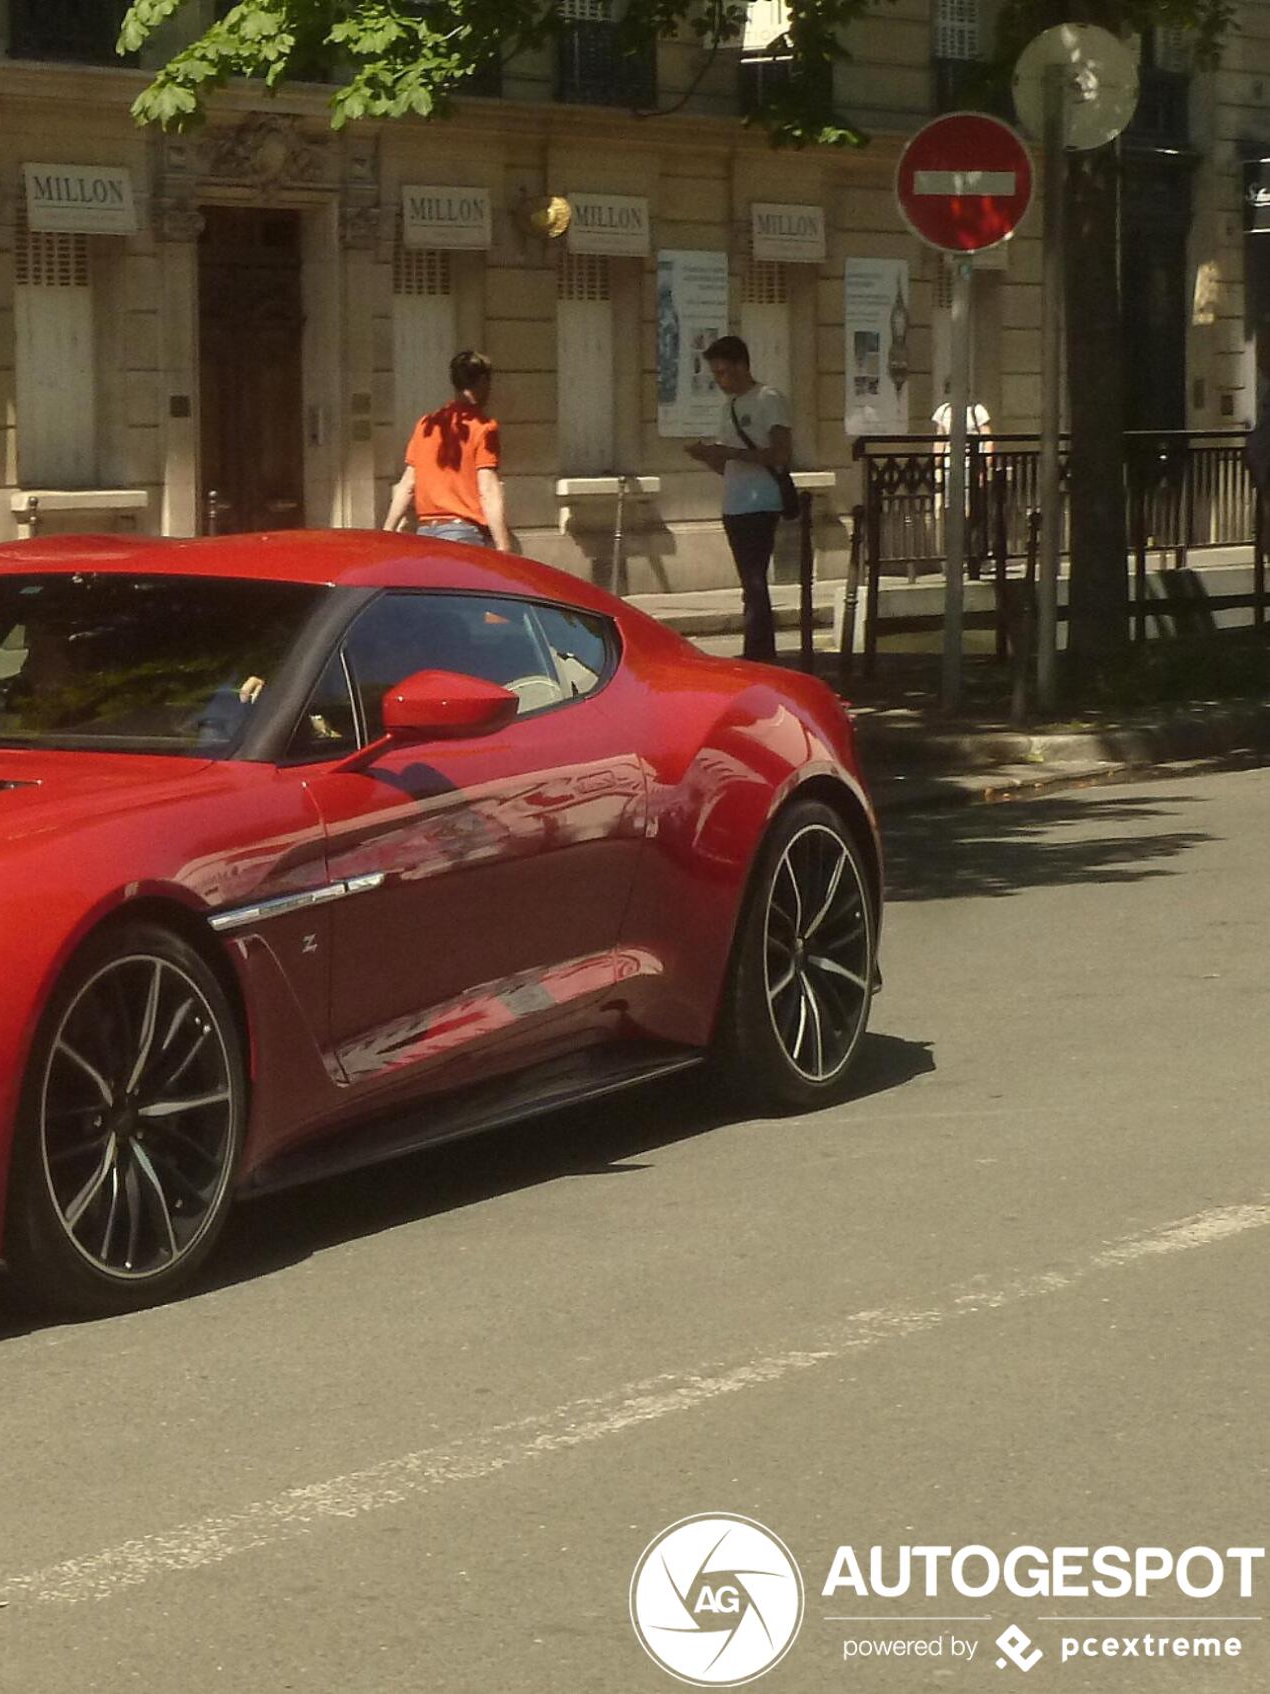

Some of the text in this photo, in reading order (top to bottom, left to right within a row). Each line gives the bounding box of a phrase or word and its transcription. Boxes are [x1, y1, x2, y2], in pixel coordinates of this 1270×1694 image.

[33, 175, 123, 203] MILLON
[409, 197, 485, 222] MILLON
[573, 203, 642, 229] MILLON
[755, 213, 819, 236] MILLON
